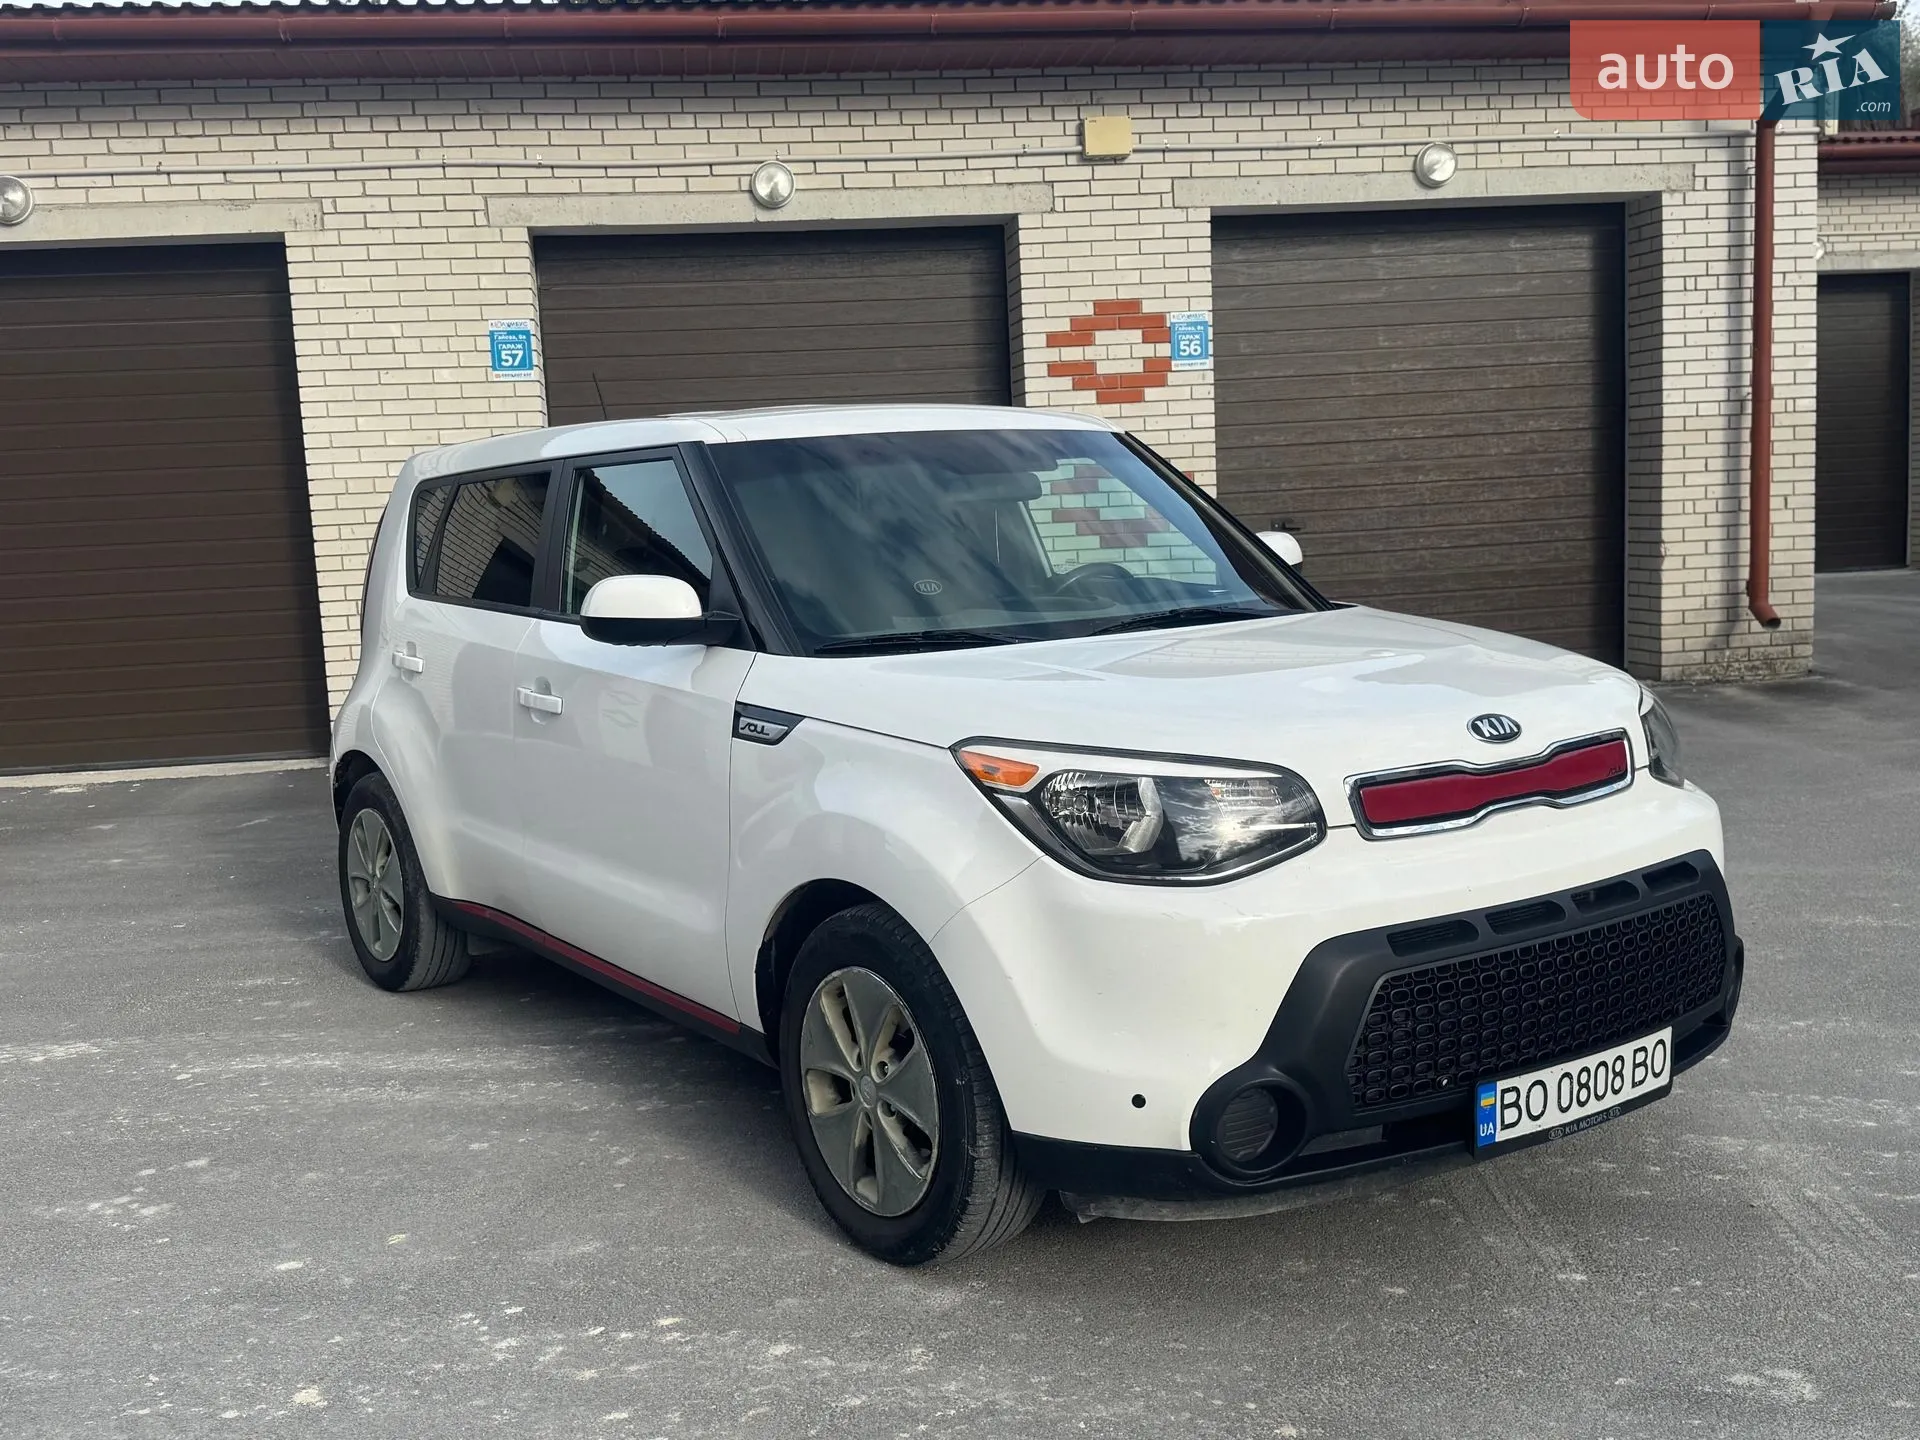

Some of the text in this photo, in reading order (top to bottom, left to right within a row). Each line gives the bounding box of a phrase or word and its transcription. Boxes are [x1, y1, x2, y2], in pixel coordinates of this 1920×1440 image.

[1180, 340, 1202, 356] 56
[501, 350, 524, 367] 57
[1474, 716, 1519, 738] KIA
[1500, 1038, 1667, 1132] BO 0808 BO
[1480, 1122, 1495, 1137] UA
[1565, 1123, 1578, 1134] KIA
[1579, 1112, 1608, 1130] MOTORS
